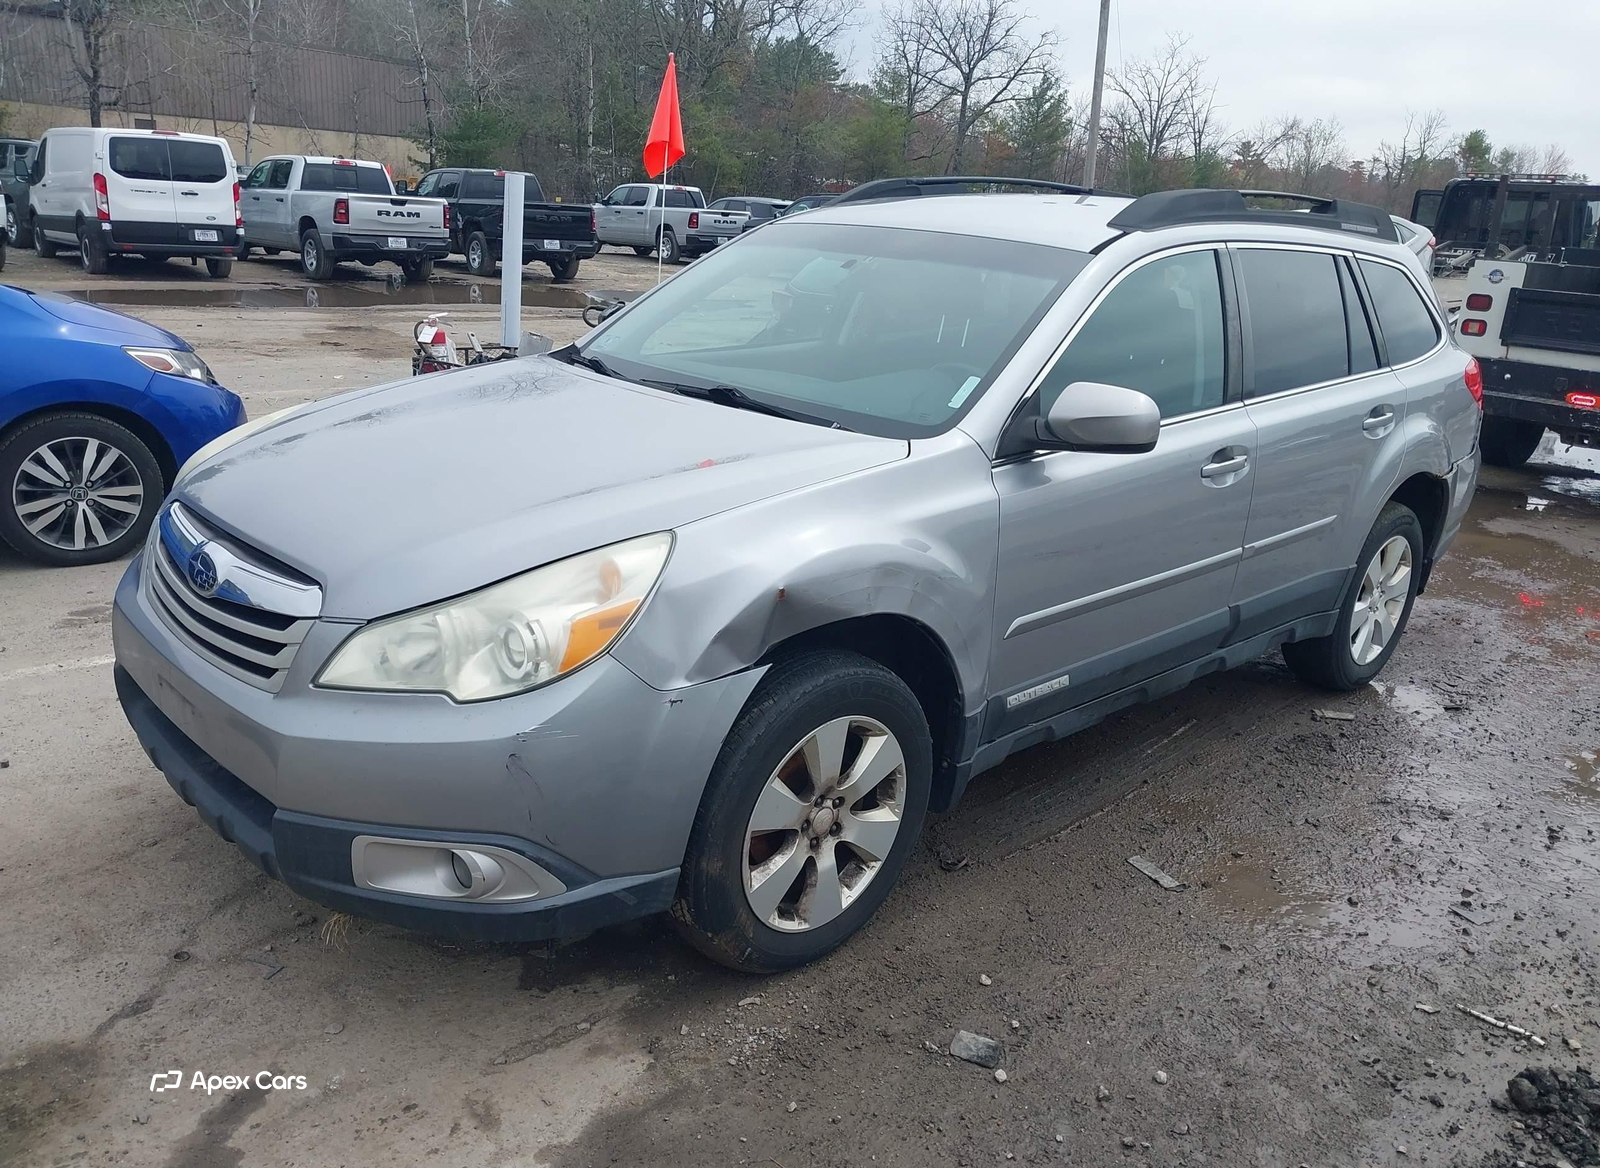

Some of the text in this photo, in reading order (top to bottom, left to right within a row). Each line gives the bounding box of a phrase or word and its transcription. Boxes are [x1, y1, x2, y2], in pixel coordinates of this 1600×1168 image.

[377, 210, 421, 219] RAM
[535, 214, 573, 222] RAM
[1008, 676, 1069, 707] OUTBACK
